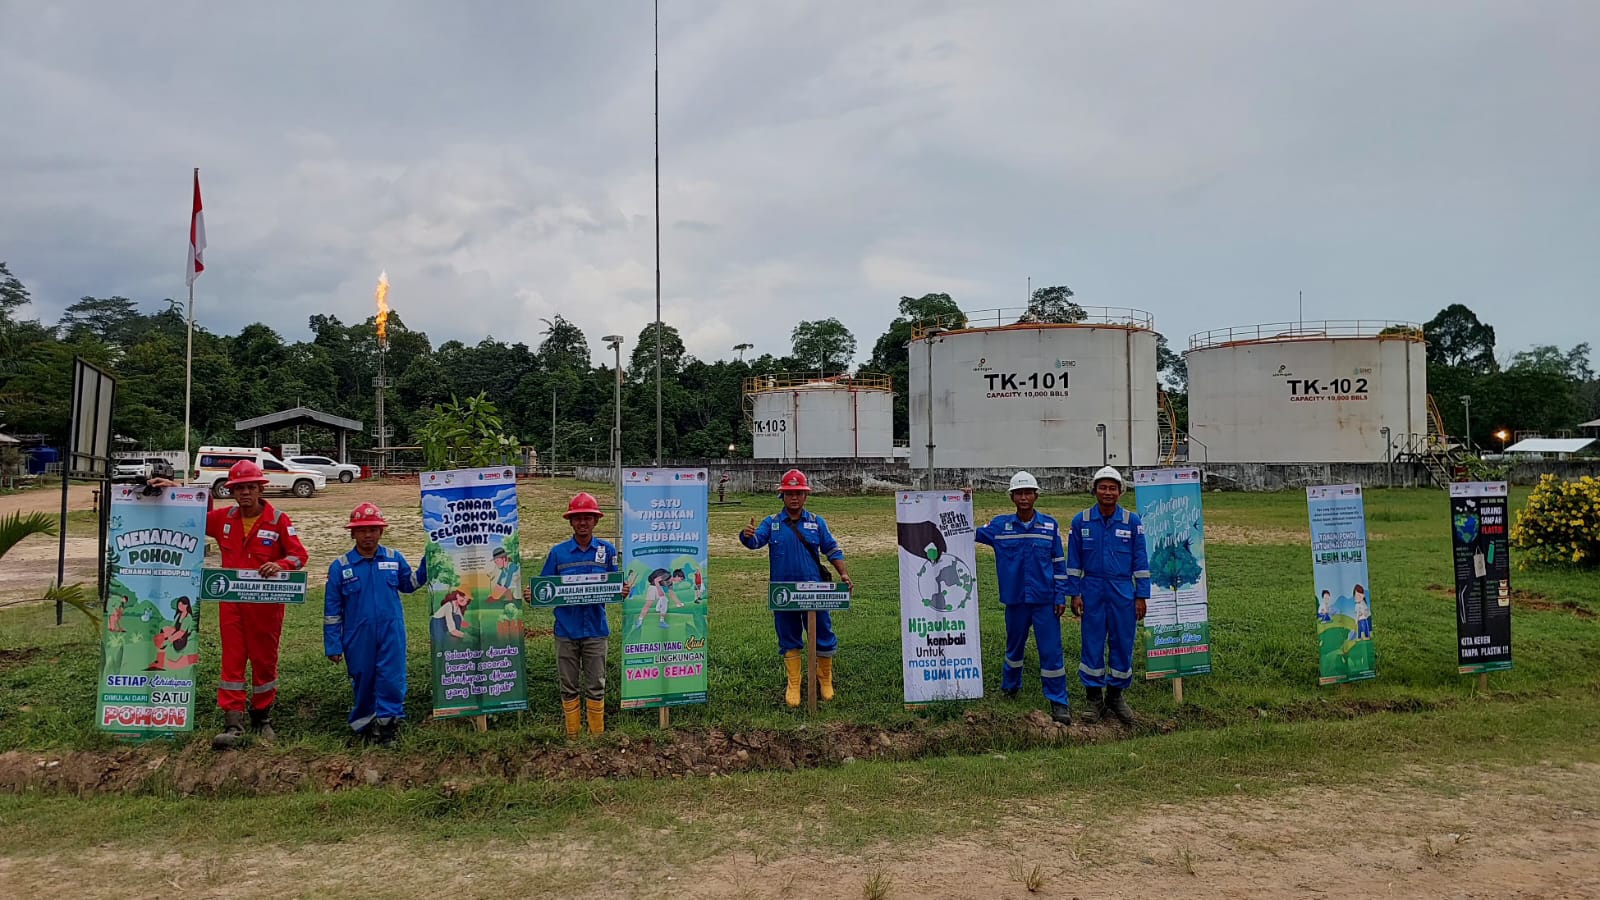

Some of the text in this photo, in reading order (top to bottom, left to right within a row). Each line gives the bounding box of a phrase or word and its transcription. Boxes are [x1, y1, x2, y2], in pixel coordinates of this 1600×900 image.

[984, 372, 1069, 390] TK-101
[447, 500, 492, 512] TANAM
[651, 499, 681, 508] SATU
[443, 511, 497, 524] 1 POHON
[639, 510, 695, 520] TINDAKAN
[941, 513, 966, 525] earth
[1481, 516, 1502, 525] SAMPAH
[430, 522, 512, 541] SELAMATKAN
[651, 521, 682, 531] SATU
[116, 528, 198, 553] MENANAM
[456, 534, 489, 546] BUMI
[631, 532, 700, 542] PERUBAHAN
[128, 549, 184, 566] POHON
[119, 568, 191, 577] MENANAM KEHIDUPAN
[262, 583, 302, 592] KEBERSIHAN
[557, 586, 583, 594] JAGALAH
[908, 617, 966, 637] Hijaukan
[927, 633, 966, 646] kembali
[625, 643, 660, 654] GENERASI
[663, 641, 682, 651] YANG
[916, 646, 945, 657] Untuk
[1461, 648, 1478, 657] TANPA
[1481, 646, 1502, 656] PLASTIK
[655, 652, 705, 663] LINGKUNGAN
[909, 656, 973, 668] masa depan
[626, 664, 702, 680] YANG SEHAT
[923, 667, 980, 681] BUMI KITA
[107, 675, 147, 686] SETIAP
[104, 694, 131, 702] DIMULAI
[152, 692, 189, 703] SATU
[445, 687, 469, 699] yang
[102, 706, 186, 727] POHON
